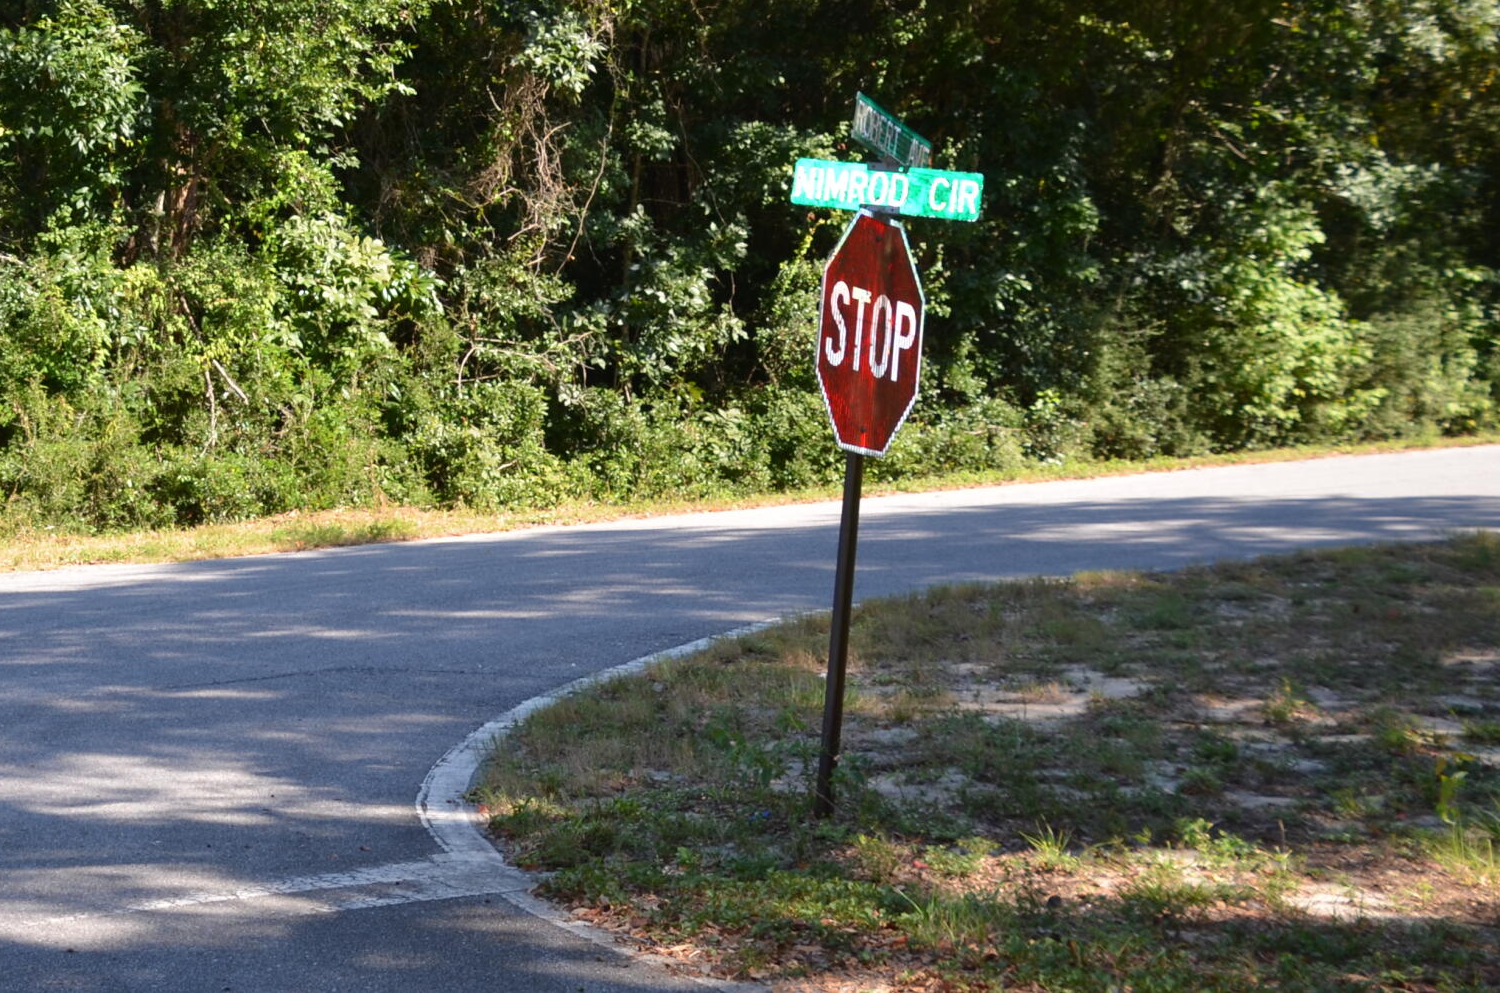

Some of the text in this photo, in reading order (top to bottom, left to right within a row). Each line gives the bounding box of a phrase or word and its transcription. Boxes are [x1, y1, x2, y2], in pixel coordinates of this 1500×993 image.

[793, 165, 980, 214] NIMROD CIR
[825, 280, 917, 382] STOP
